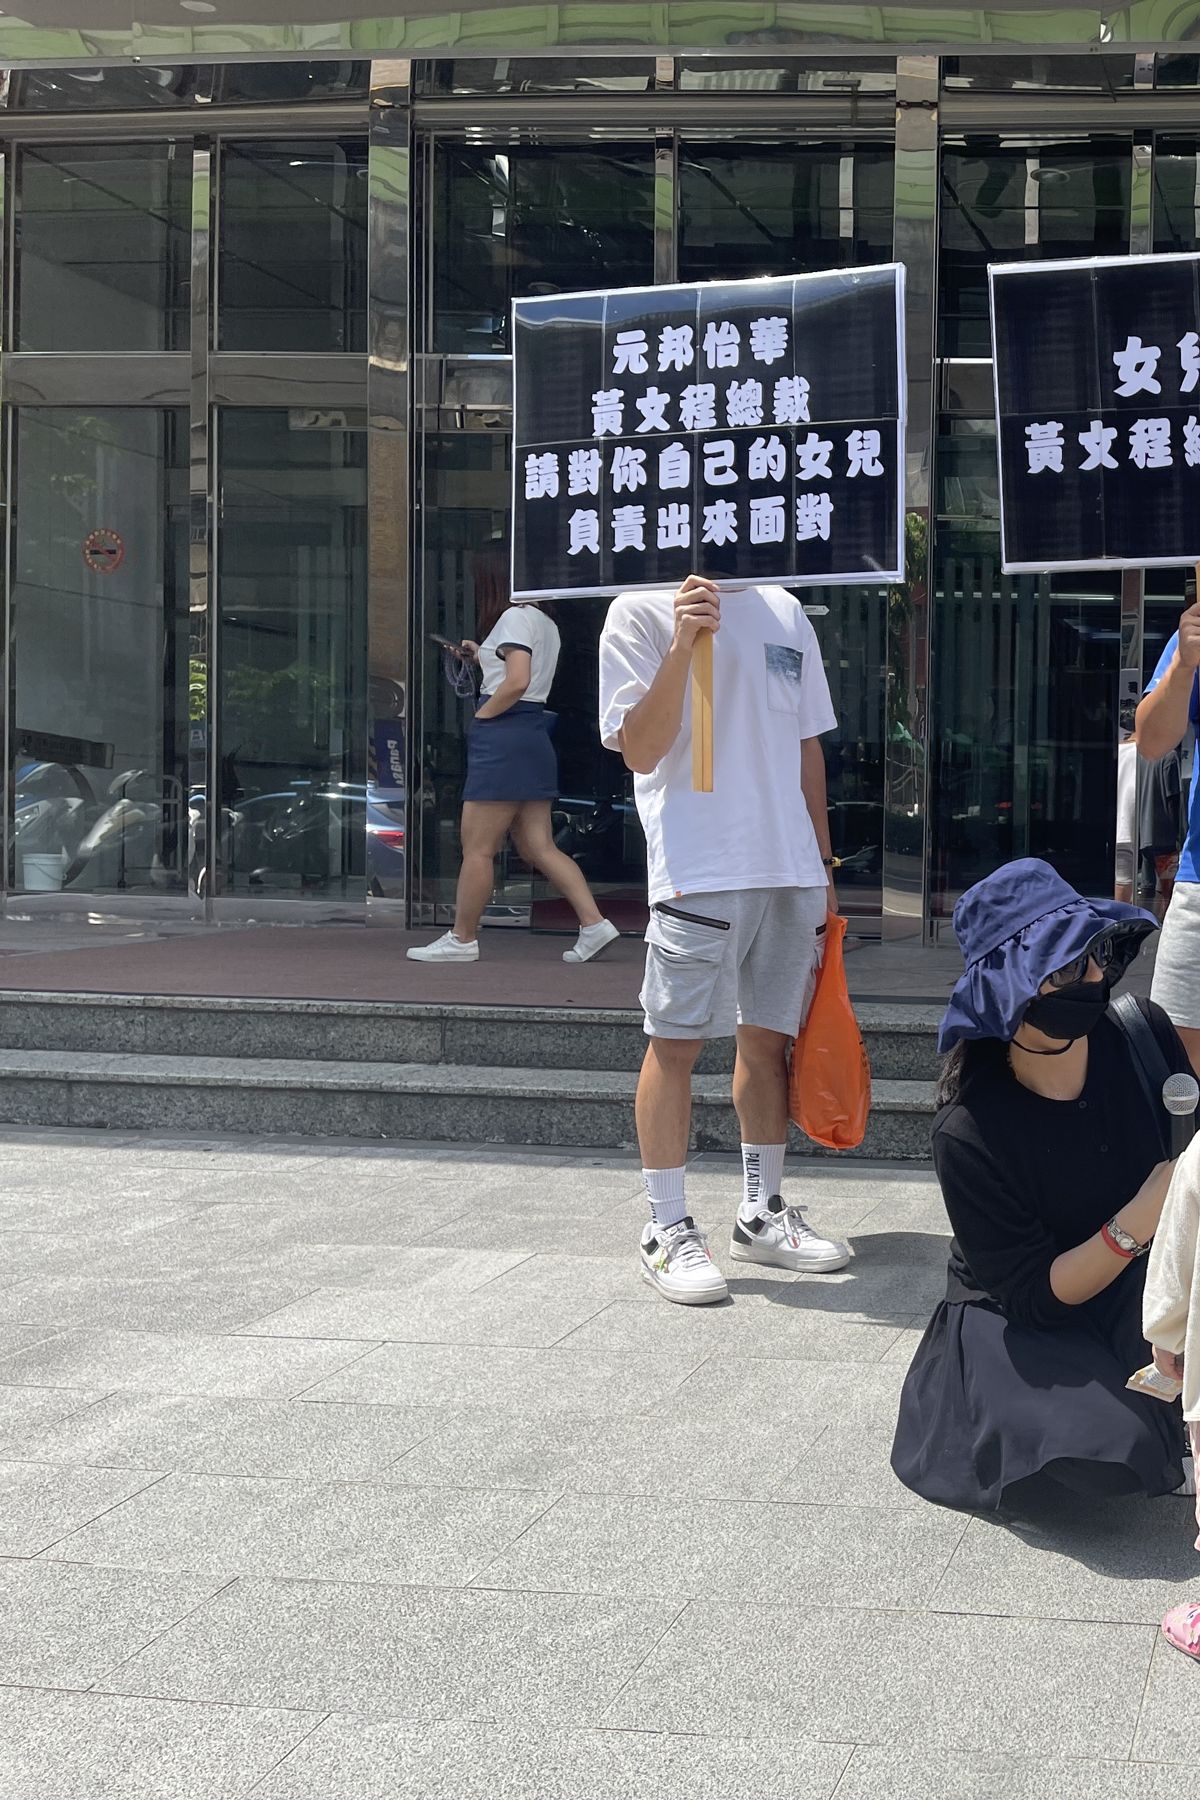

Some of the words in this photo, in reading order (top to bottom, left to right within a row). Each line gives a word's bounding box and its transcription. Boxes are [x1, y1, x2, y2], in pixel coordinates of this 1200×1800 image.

[612, 316, 789, 374] 元邦怡華
[591, 375, 811, 437] 黃文程總裁
[524, 430, 884, 499] 請對你自己的女兒
[567, 492, 834, 555] 負責出來面對
[745, 1153, 760, 1203] PALLADIUM
